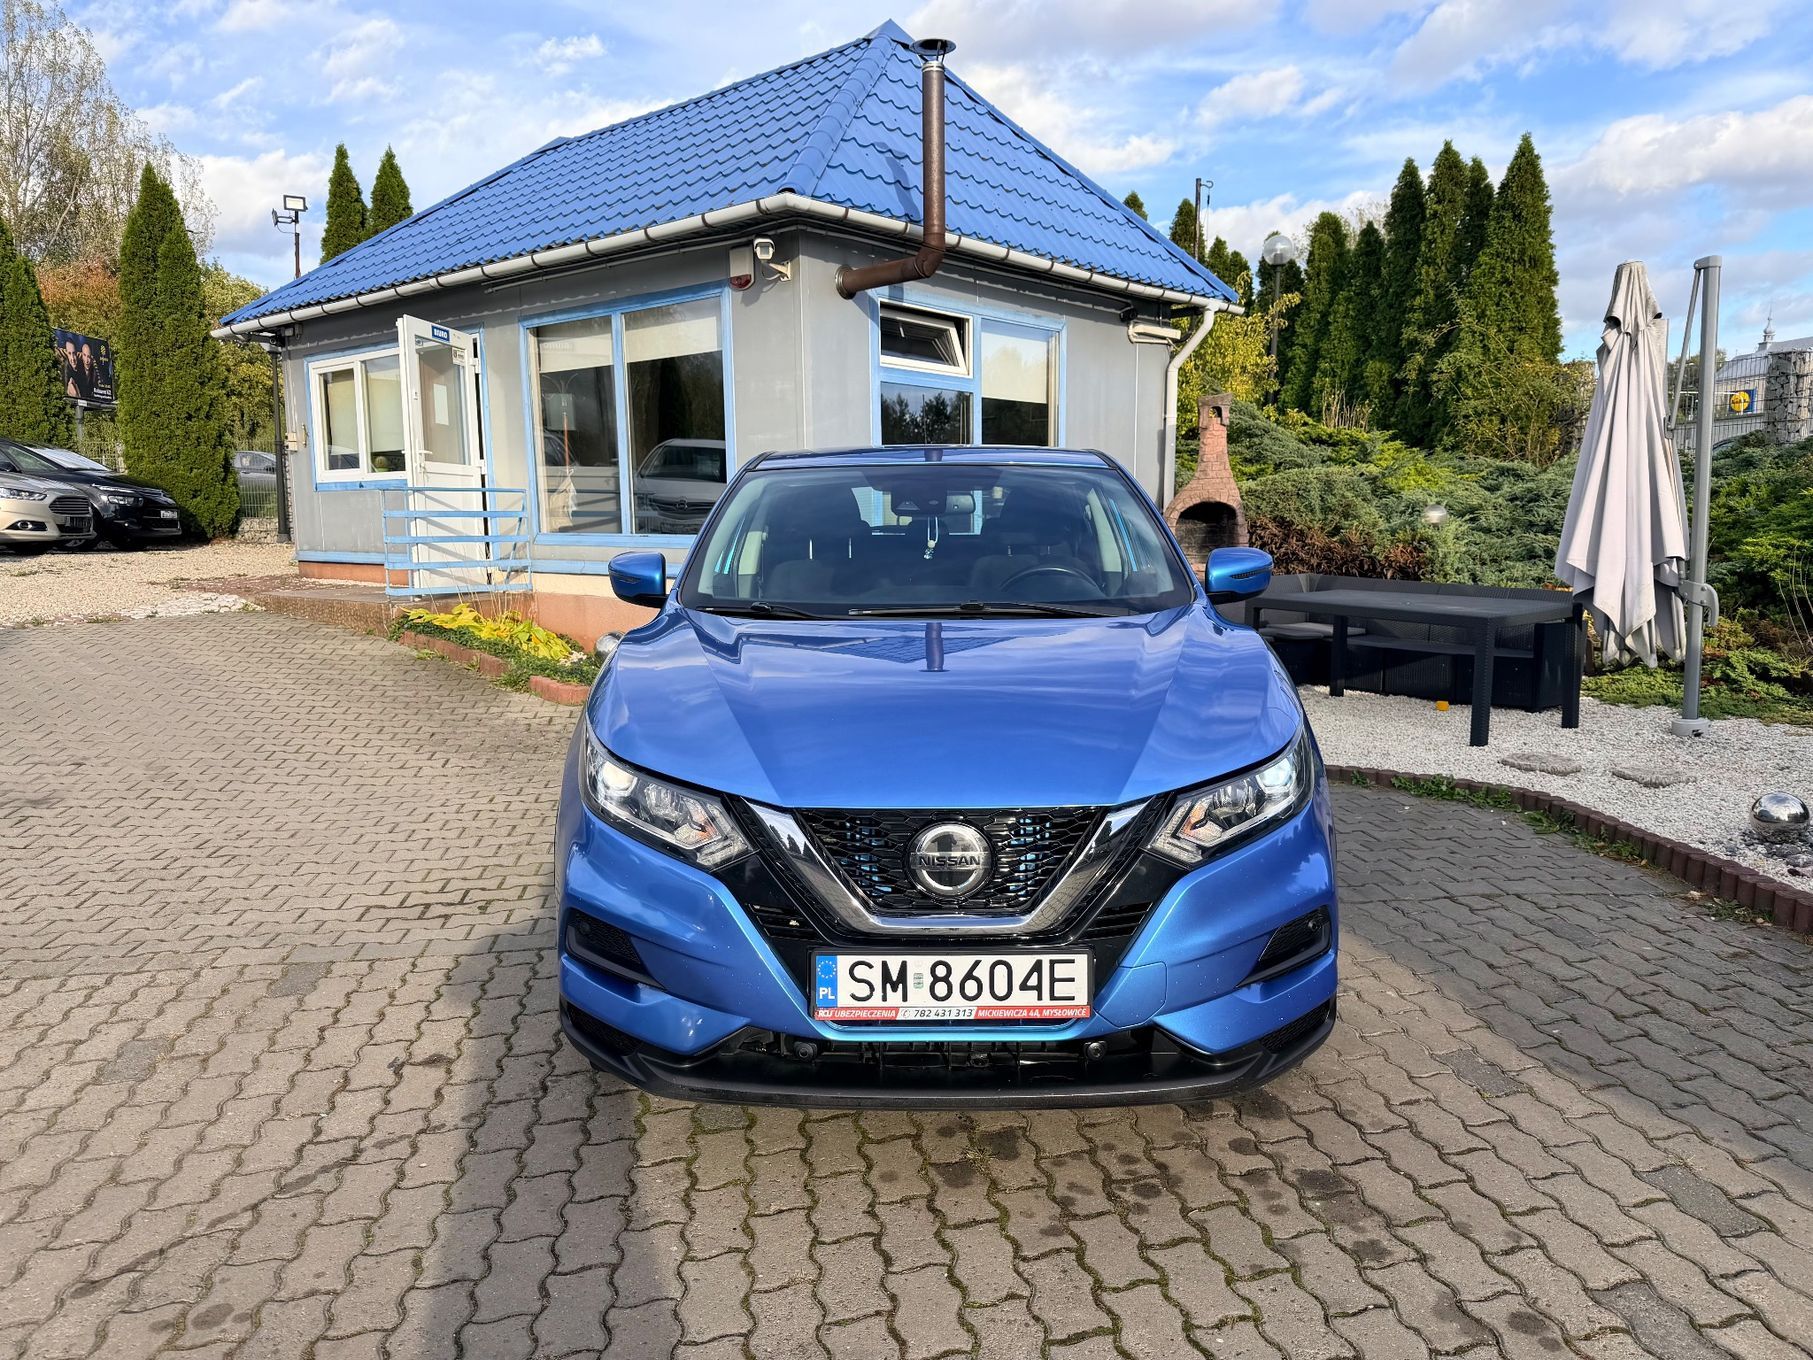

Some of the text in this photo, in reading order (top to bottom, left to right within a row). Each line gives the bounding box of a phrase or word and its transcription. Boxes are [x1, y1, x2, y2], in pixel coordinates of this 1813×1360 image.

[919, 856, 980, 866] NISSAN
[848, 959, 1076, 1002] SM 8604E
[819, 987, 835, 999] PL
[834, 1009, 896, 1018] UBEZPIECZENIA
[914, 1009, 932, 1018] 782
[934, 1009, 952, 1018] 431
[955, 1008, 973, 1018] 313
[977, 1009, 1027, 1017] MICKIEWICZA
[1042, 1008, 1087, 1017] MYSŁOWICE
